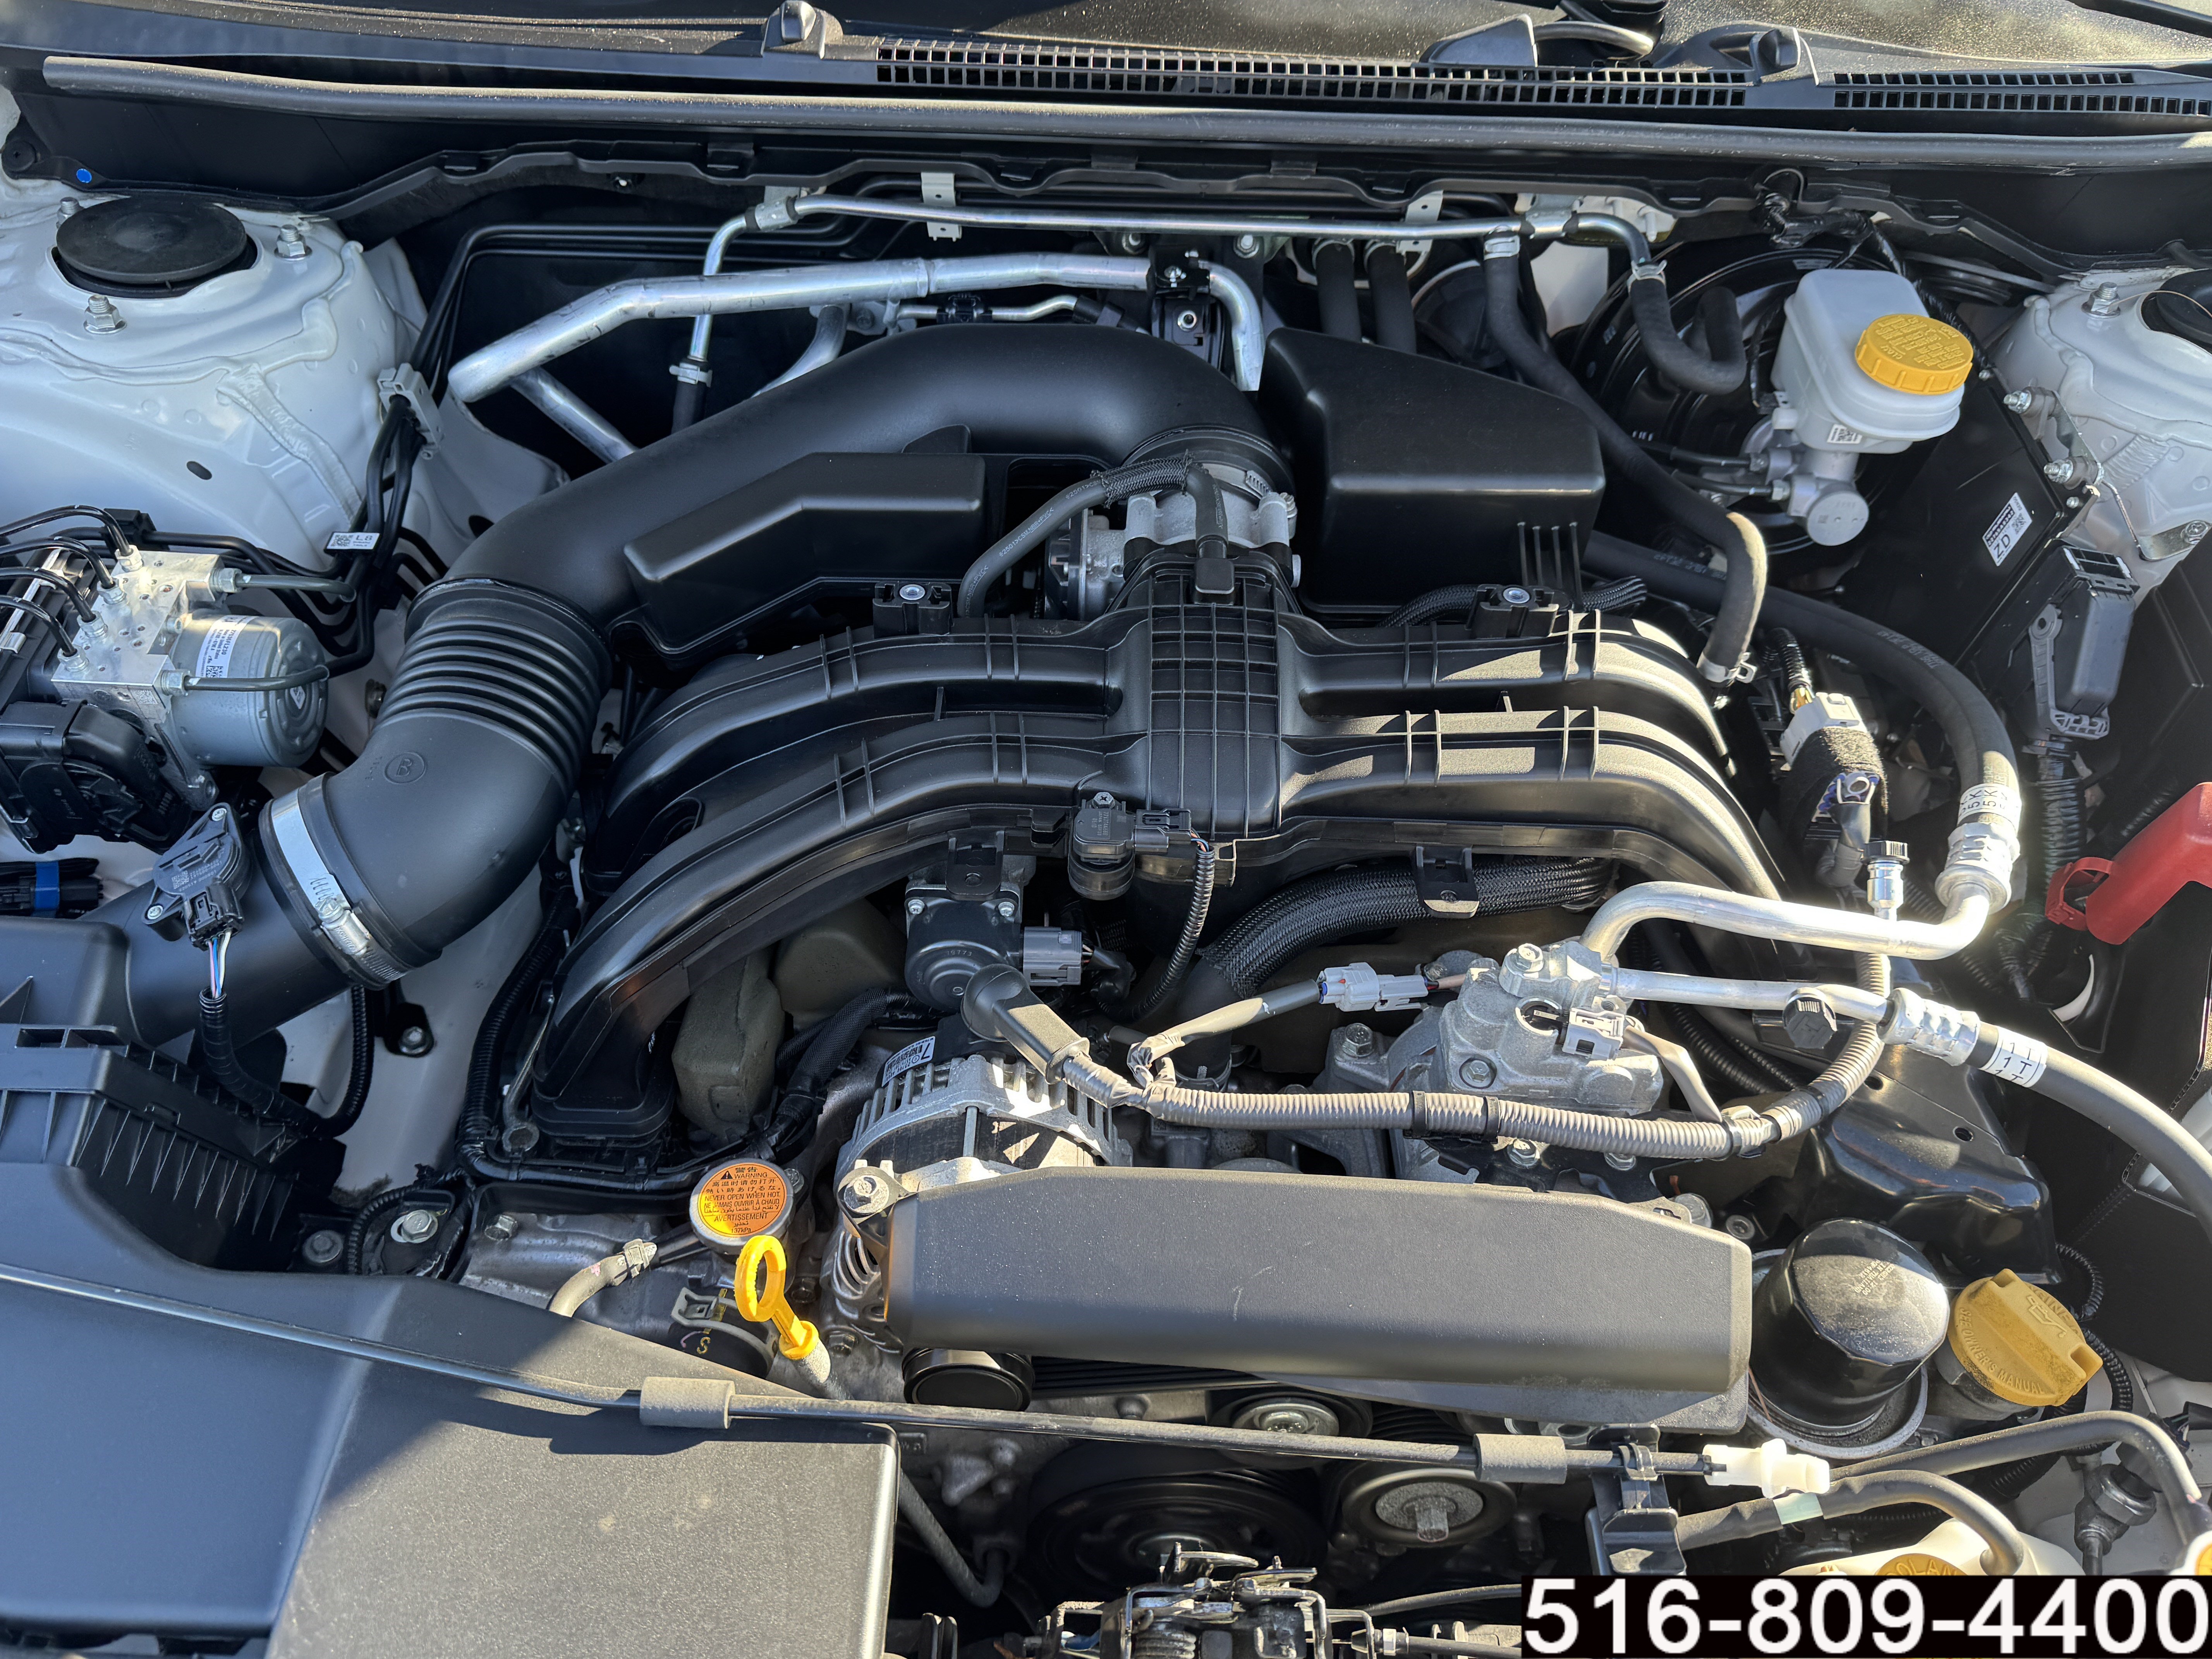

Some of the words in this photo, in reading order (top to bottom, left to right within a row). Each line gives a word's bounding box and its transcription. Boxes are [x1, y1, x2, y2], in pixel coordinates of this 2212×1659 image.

[1994, 534, 2011, 558] ZD
[396, 758, 413, 776] B
[1968, 790, 1982, 809] 5K
[1983, 790, 1998, 807] 5K
[921, 1042, 931, 1060] 7
[714, 1212, 768, 1222] AVERTISSEMENT
[1960, 1307, 1972, 1328] SEE
[697, 1336, 711, 1354] S
[1961, 1329, 1998, 1373] OWNER'S
[1997, 1369, 2045, 1395] MANUAL
